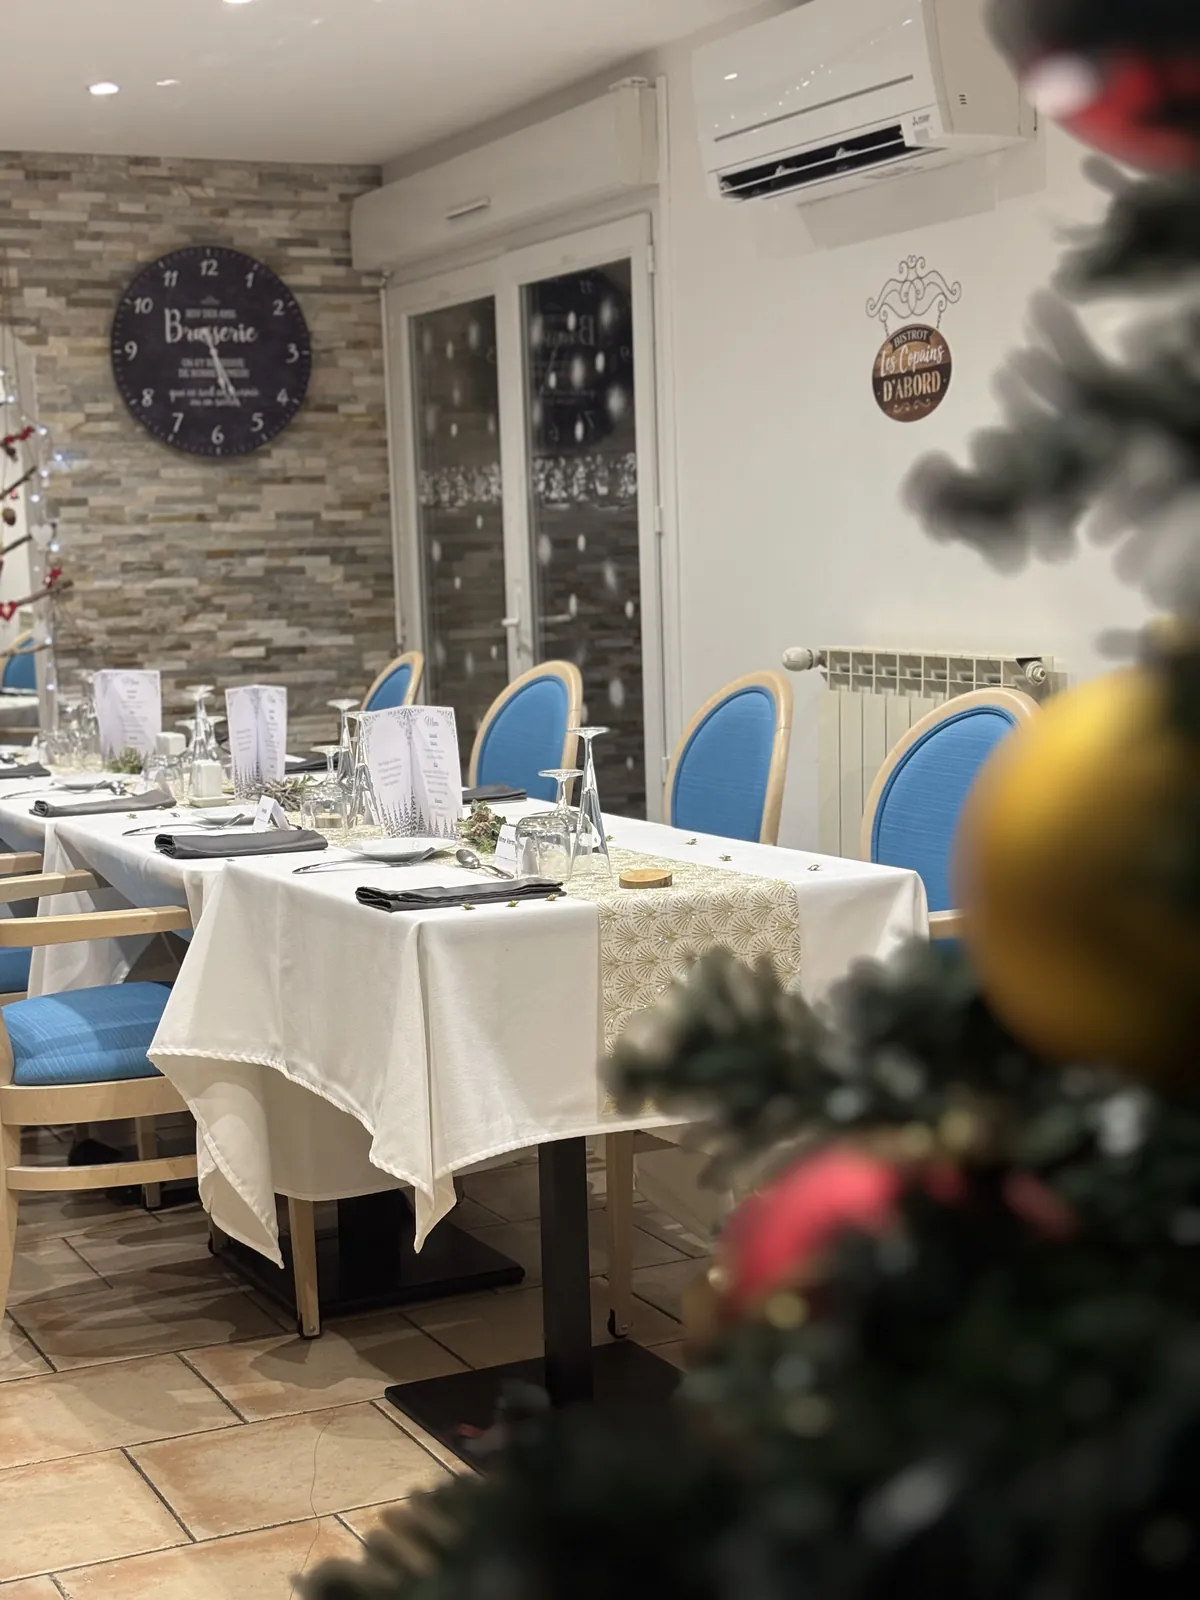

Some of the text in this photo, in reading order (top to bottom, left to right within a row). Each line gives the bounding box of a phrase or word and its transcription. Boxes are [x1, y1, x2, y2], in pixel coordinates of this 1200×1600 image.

[201, 259, 219, 276] 12
[163, 270, 179, 287] 11
[245, 272, 254, 288] 1
[134, 297, 154, 314] 10
[273, 299, 286, 316] 2
[893, 329, 929, 348] BISTROT
[124, 341, 138, 361] 9
[285, 343, 299, 363] 3
[880, 344, 945, 377] Les Copains
[883, 370, 941, 402] D'ABORD
[141, 388, 155, 408] 8
[276, 388, 289, 406] 4
[172, 412, 184, 433] 7
[251, 412, 264, 432] 5
[211, 425, 225, 445] 6
